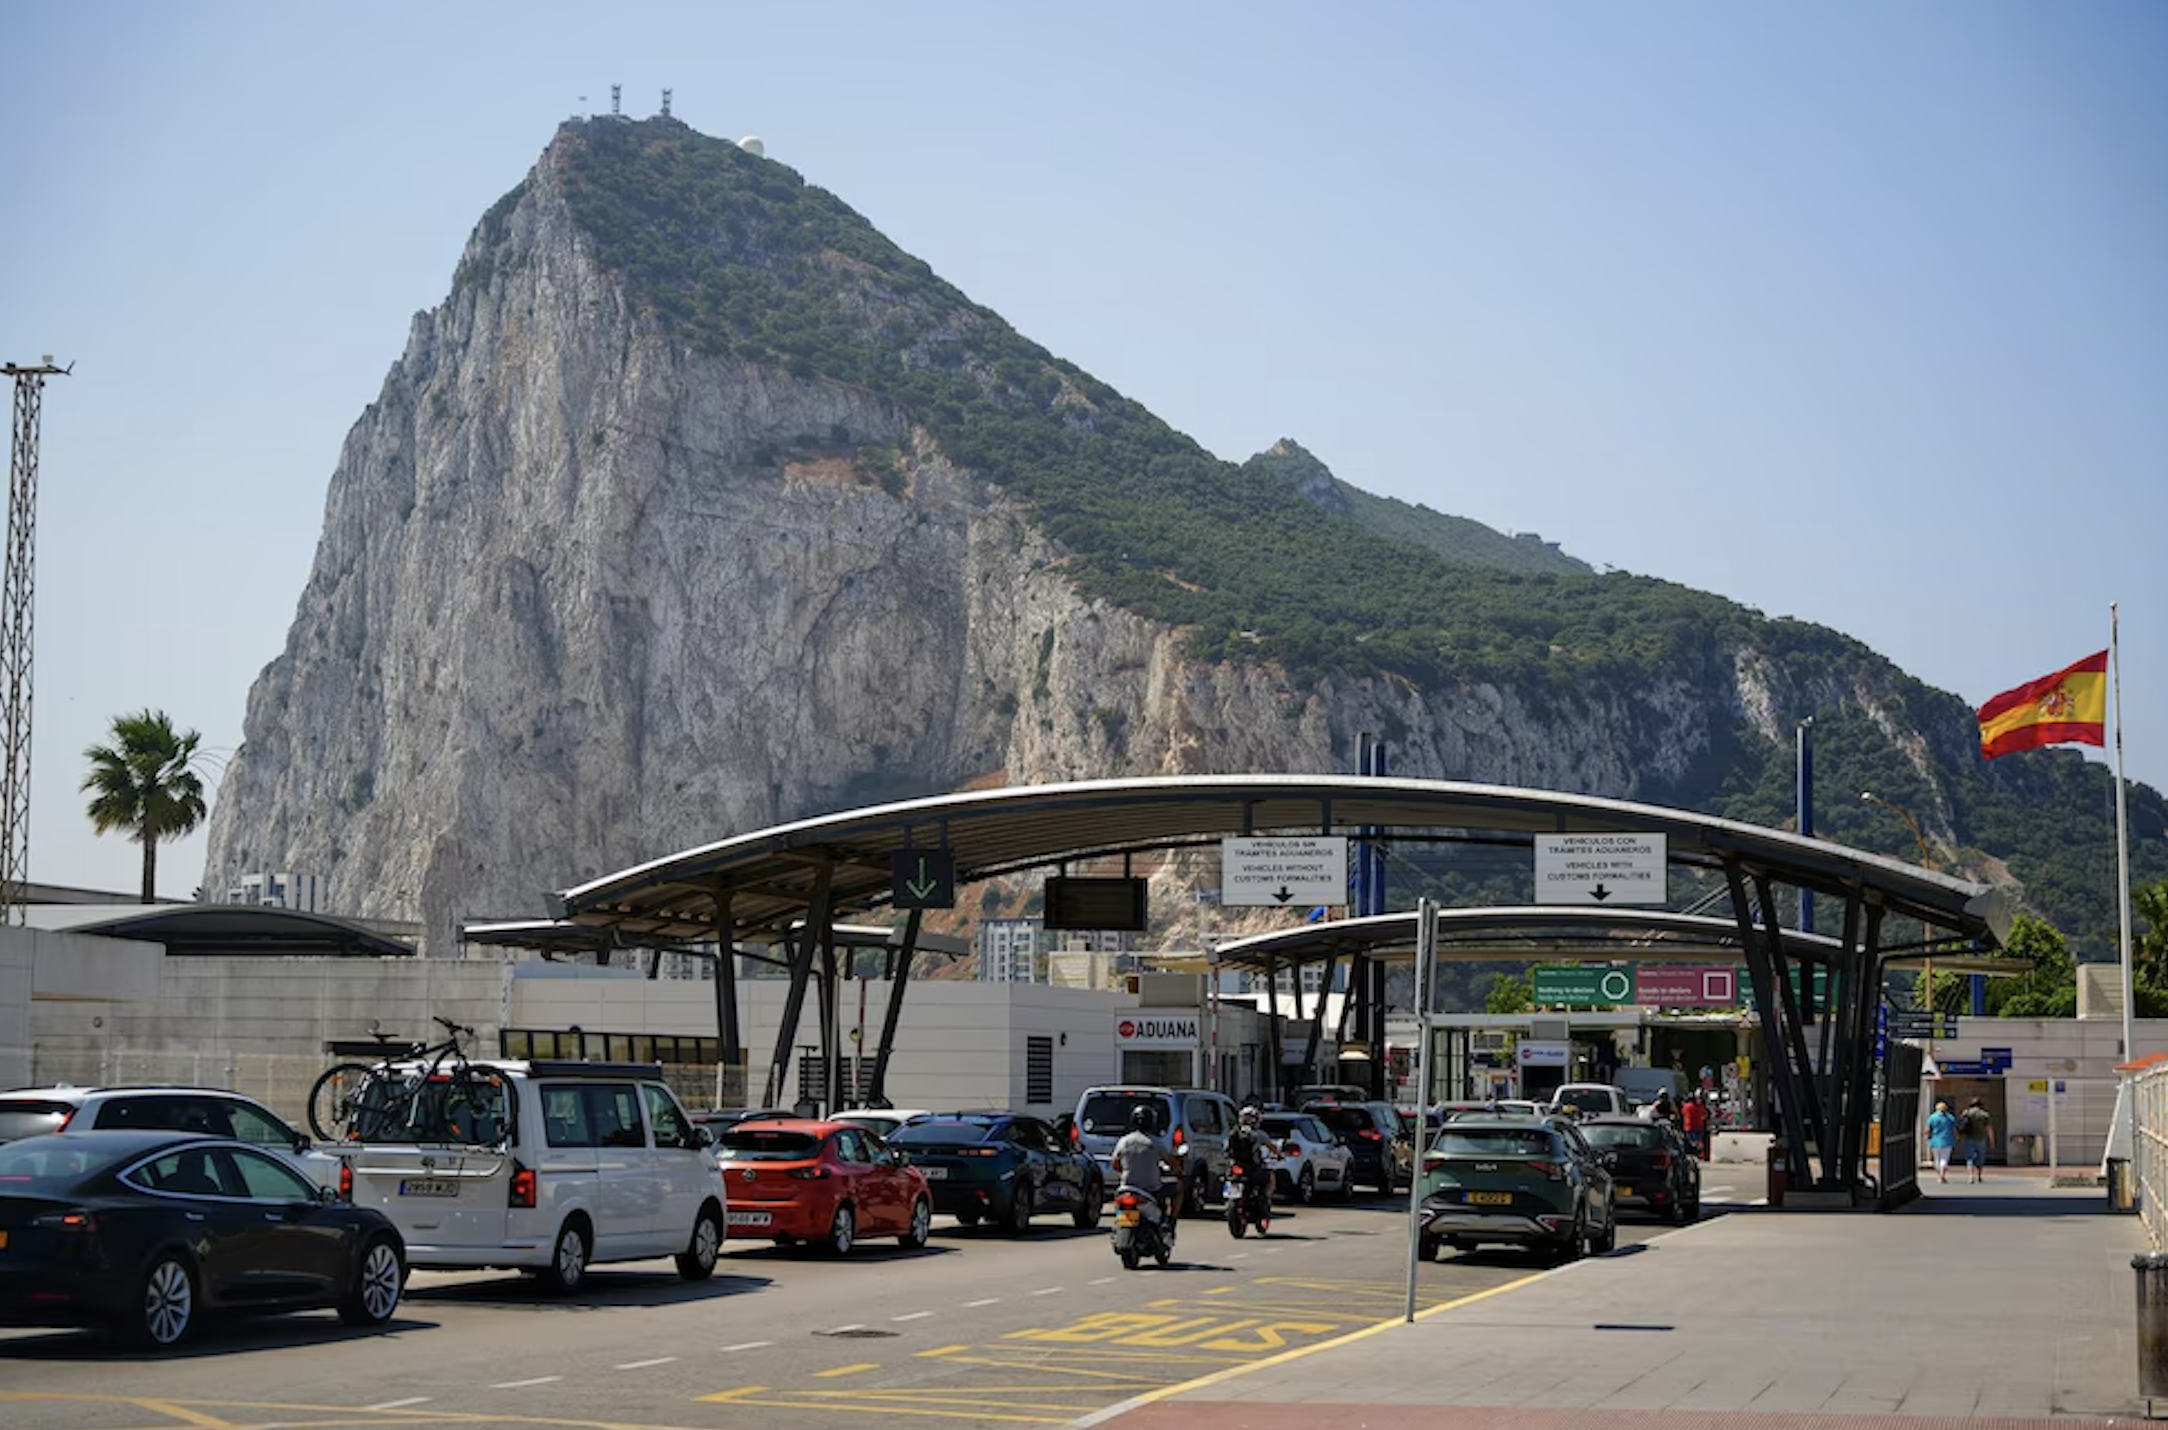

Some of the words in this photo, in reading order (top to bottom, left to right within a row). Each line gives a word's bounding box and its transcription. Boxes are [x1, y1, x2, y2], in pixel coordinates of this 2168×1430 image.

[1616, 837, 1637, 845] CON
[1279, 849, 1333, 857] ADUANEROS
[1595, 846, 1651, 854] ADUANEROS
[1241, 864, 1283, 872] VEHICLES
[1286, 864, 1324, 872] WITHOUT
[1565, 862, 1608, 870] VEHICLES
[1233, 874, 1274, 883] CUSTOMS
[1276, 874, 1333, 882] FORMALITIES
[1547, 872, 1590, 881] CUSTOMS
[1592, 872, 1651, 881] FORMALITIES
[1136, 1021, 1197, 1038] ADUANA
[1028, 1313, 1340, 1350] BUS
